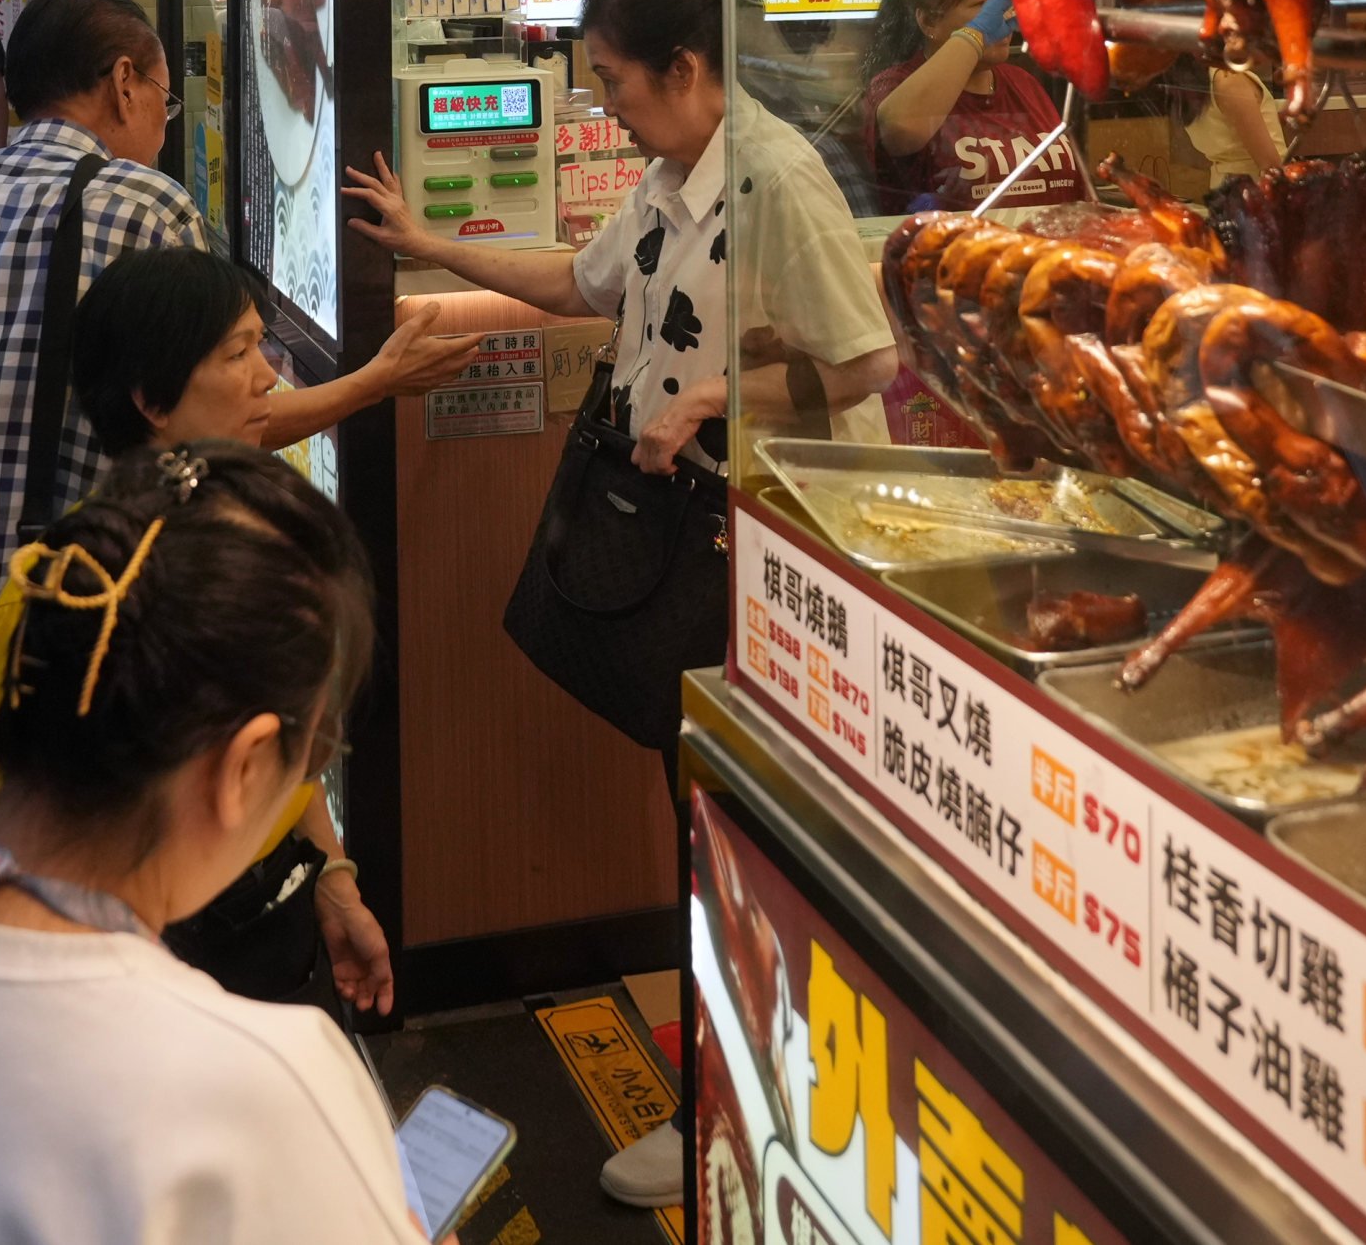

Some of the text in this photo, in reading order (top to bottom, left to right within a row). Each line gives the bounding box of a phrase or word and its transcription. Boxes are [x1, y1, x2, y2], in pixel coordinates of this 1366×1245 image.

[433, 95, 499, 113] 超級快充
[555, 120, 636, 153] 多謝打
[560, 158, 644, 201] Tips Box
[459, 362, 537, 380] 搭枱入座
[481, 335, 536, 352] 忙時段
[763, 548, 849, 659] 棋哥燒鵝
[831, 668, 870, 717] $270
[881, 631, 993, 768] 棋哥叉燒
[832, 710, 868, 757] $145
[881, 715, 1025, 878] 脆皮燒腩仔
[1082, 793, 1142, 864] $70
[1082, 890, 1143, 968] $75
[1160, 831, 1347, 1035] 桂香切雞
[1160, 934, 1347, 1153] 桶子油雞
[807, 937, 1093, 1245] 外賣
